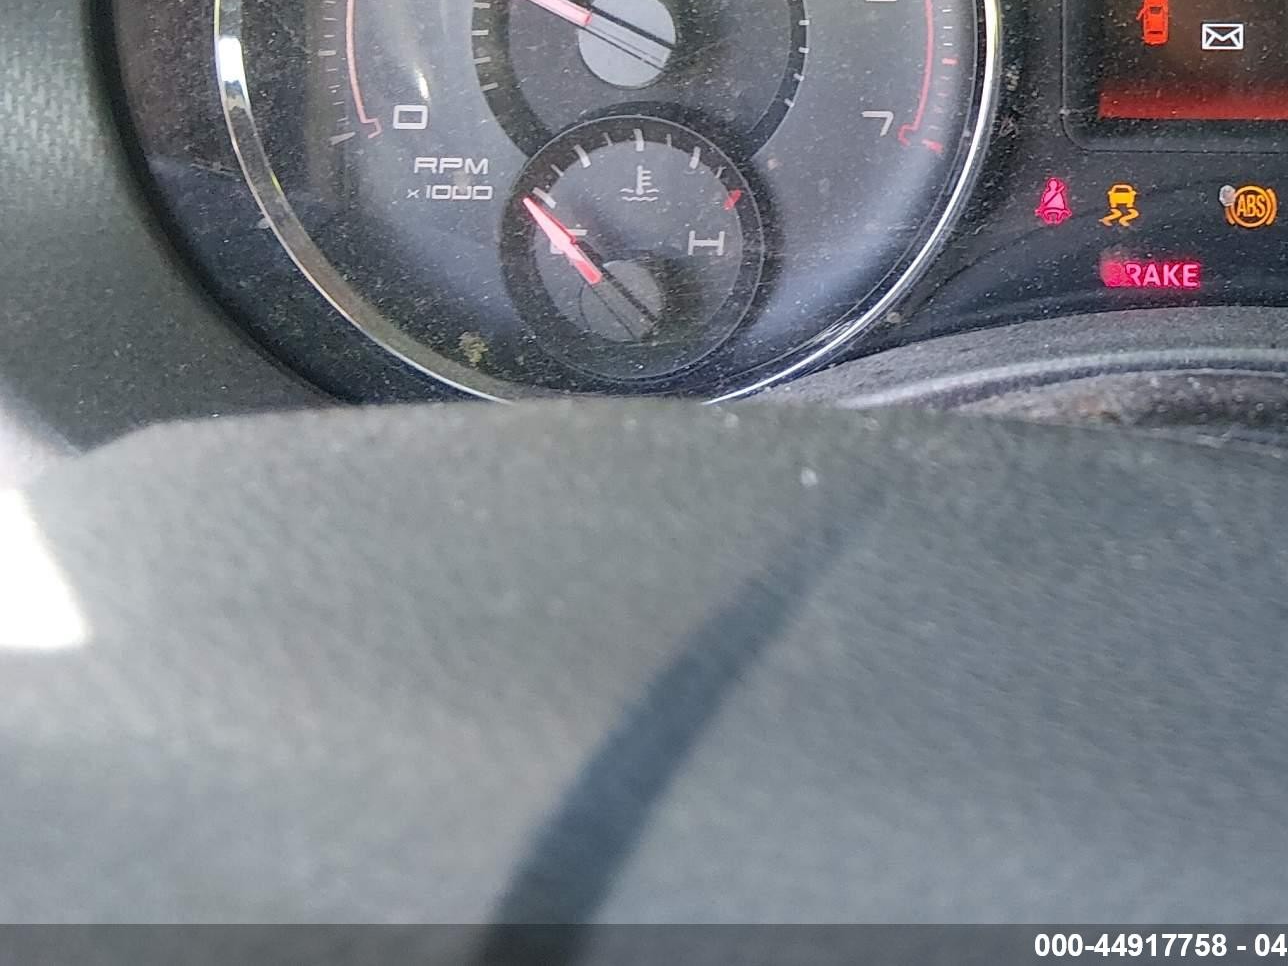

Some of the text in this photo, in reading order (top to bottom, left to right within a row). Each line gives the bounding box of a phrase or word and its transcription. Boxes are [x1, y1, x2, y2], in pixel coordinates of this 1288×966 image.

[393, 104, 428, 130] 0
[861, 110, 893, 137] 7
[413, 156, 490, 176] RPM
[1236, 195, 1267, 218] ABS
[687, 230, 725, 256] H
[1106, 262, 1199, 287] RAKE
